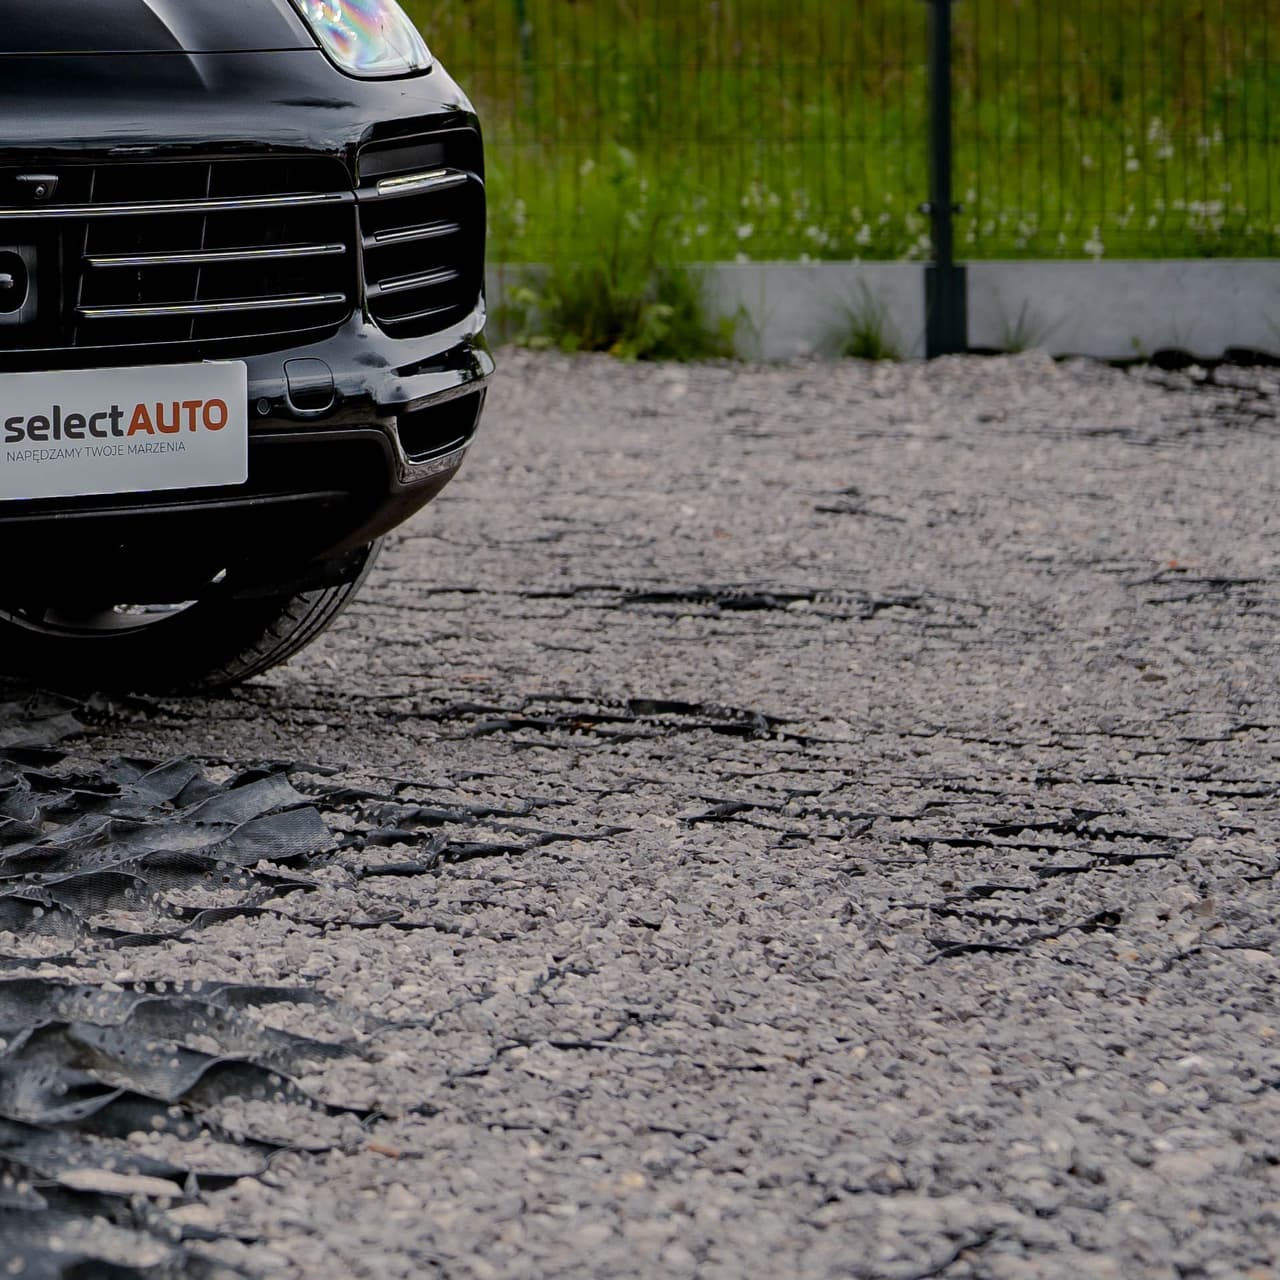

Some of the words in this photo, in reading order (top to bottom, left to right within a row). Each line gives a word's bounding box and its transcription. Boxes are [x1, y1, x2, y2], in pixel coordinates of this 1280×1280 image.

[4, 398, 228, 443] selectAUTO
[6, 446, 82, 463] NAPĘDZAMY
[84, 444, 125, 457] TWOJE
[127, 441, 186, 455] MARZENIA
